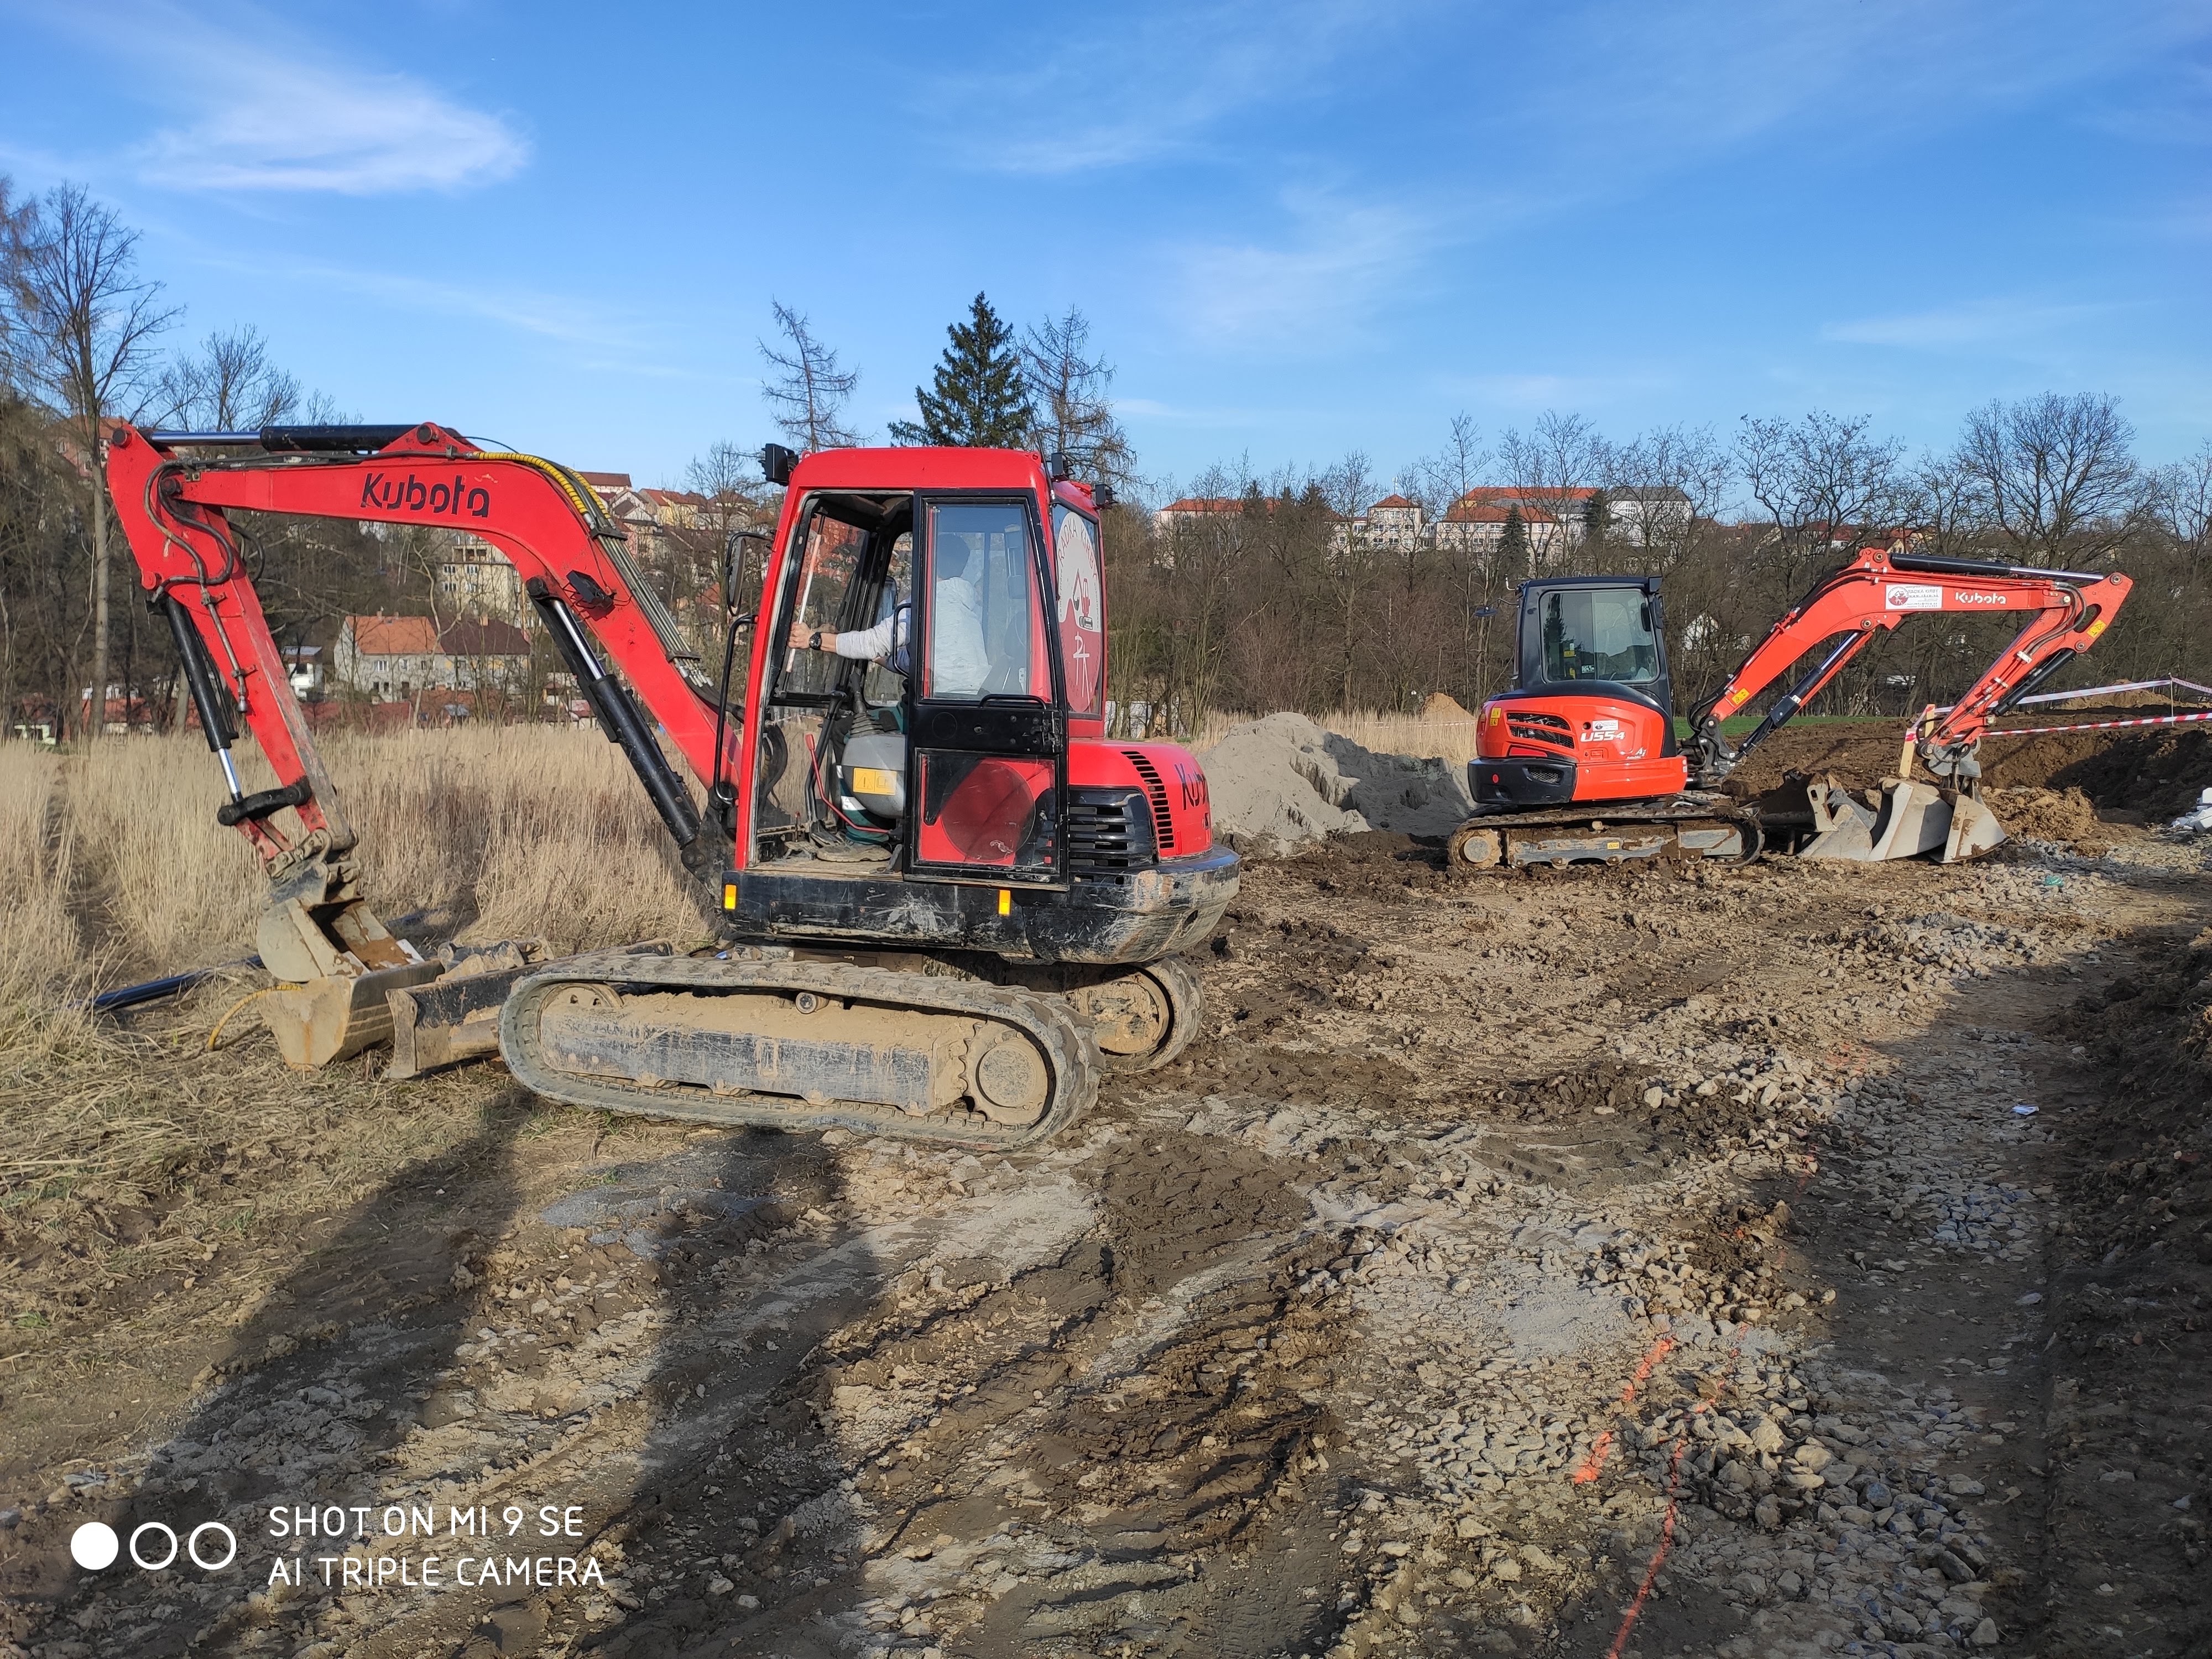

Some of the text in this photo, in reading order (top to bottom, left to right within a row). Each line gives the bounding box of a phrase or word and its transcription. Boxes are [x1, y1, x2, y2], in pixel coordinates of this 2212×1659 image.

[360, 473, 490, 518] Kubota
[1057, 518, 1098, 581] RADKA KIRBY
[1955, 592, 2007, 604] Kubota
